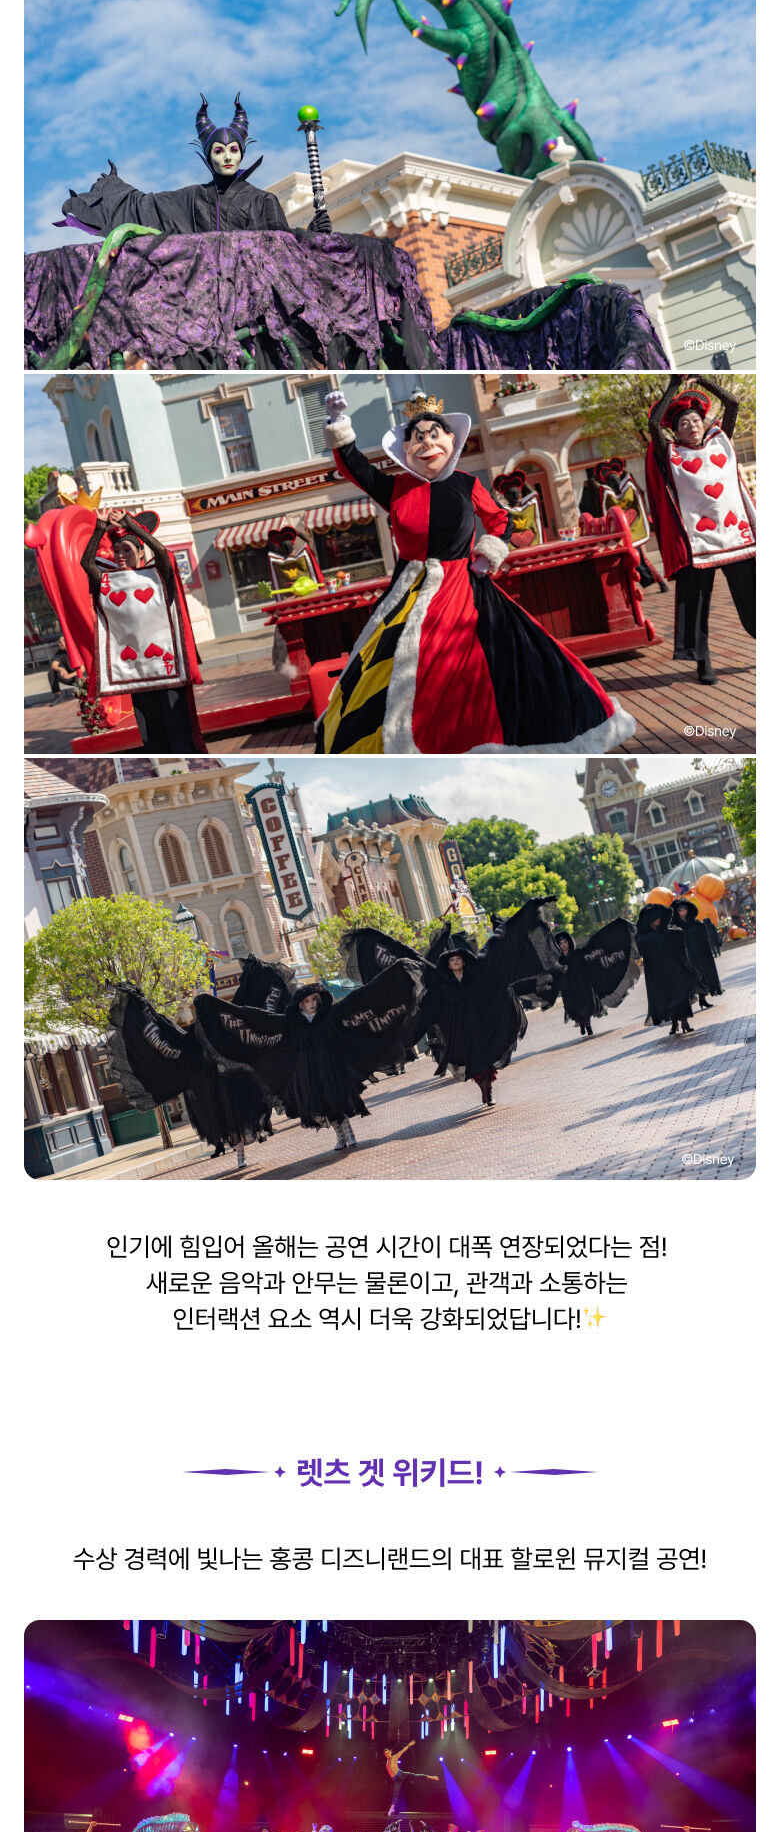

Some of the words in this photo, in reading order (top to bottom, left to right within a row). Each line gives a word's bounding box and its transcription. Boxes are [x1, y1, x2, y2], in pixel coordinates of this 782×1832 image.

[207, 489, 254, 508] MAIN
[258, 472, 329, 496] STREET
[260, 797, 303, 909] COFFEE
